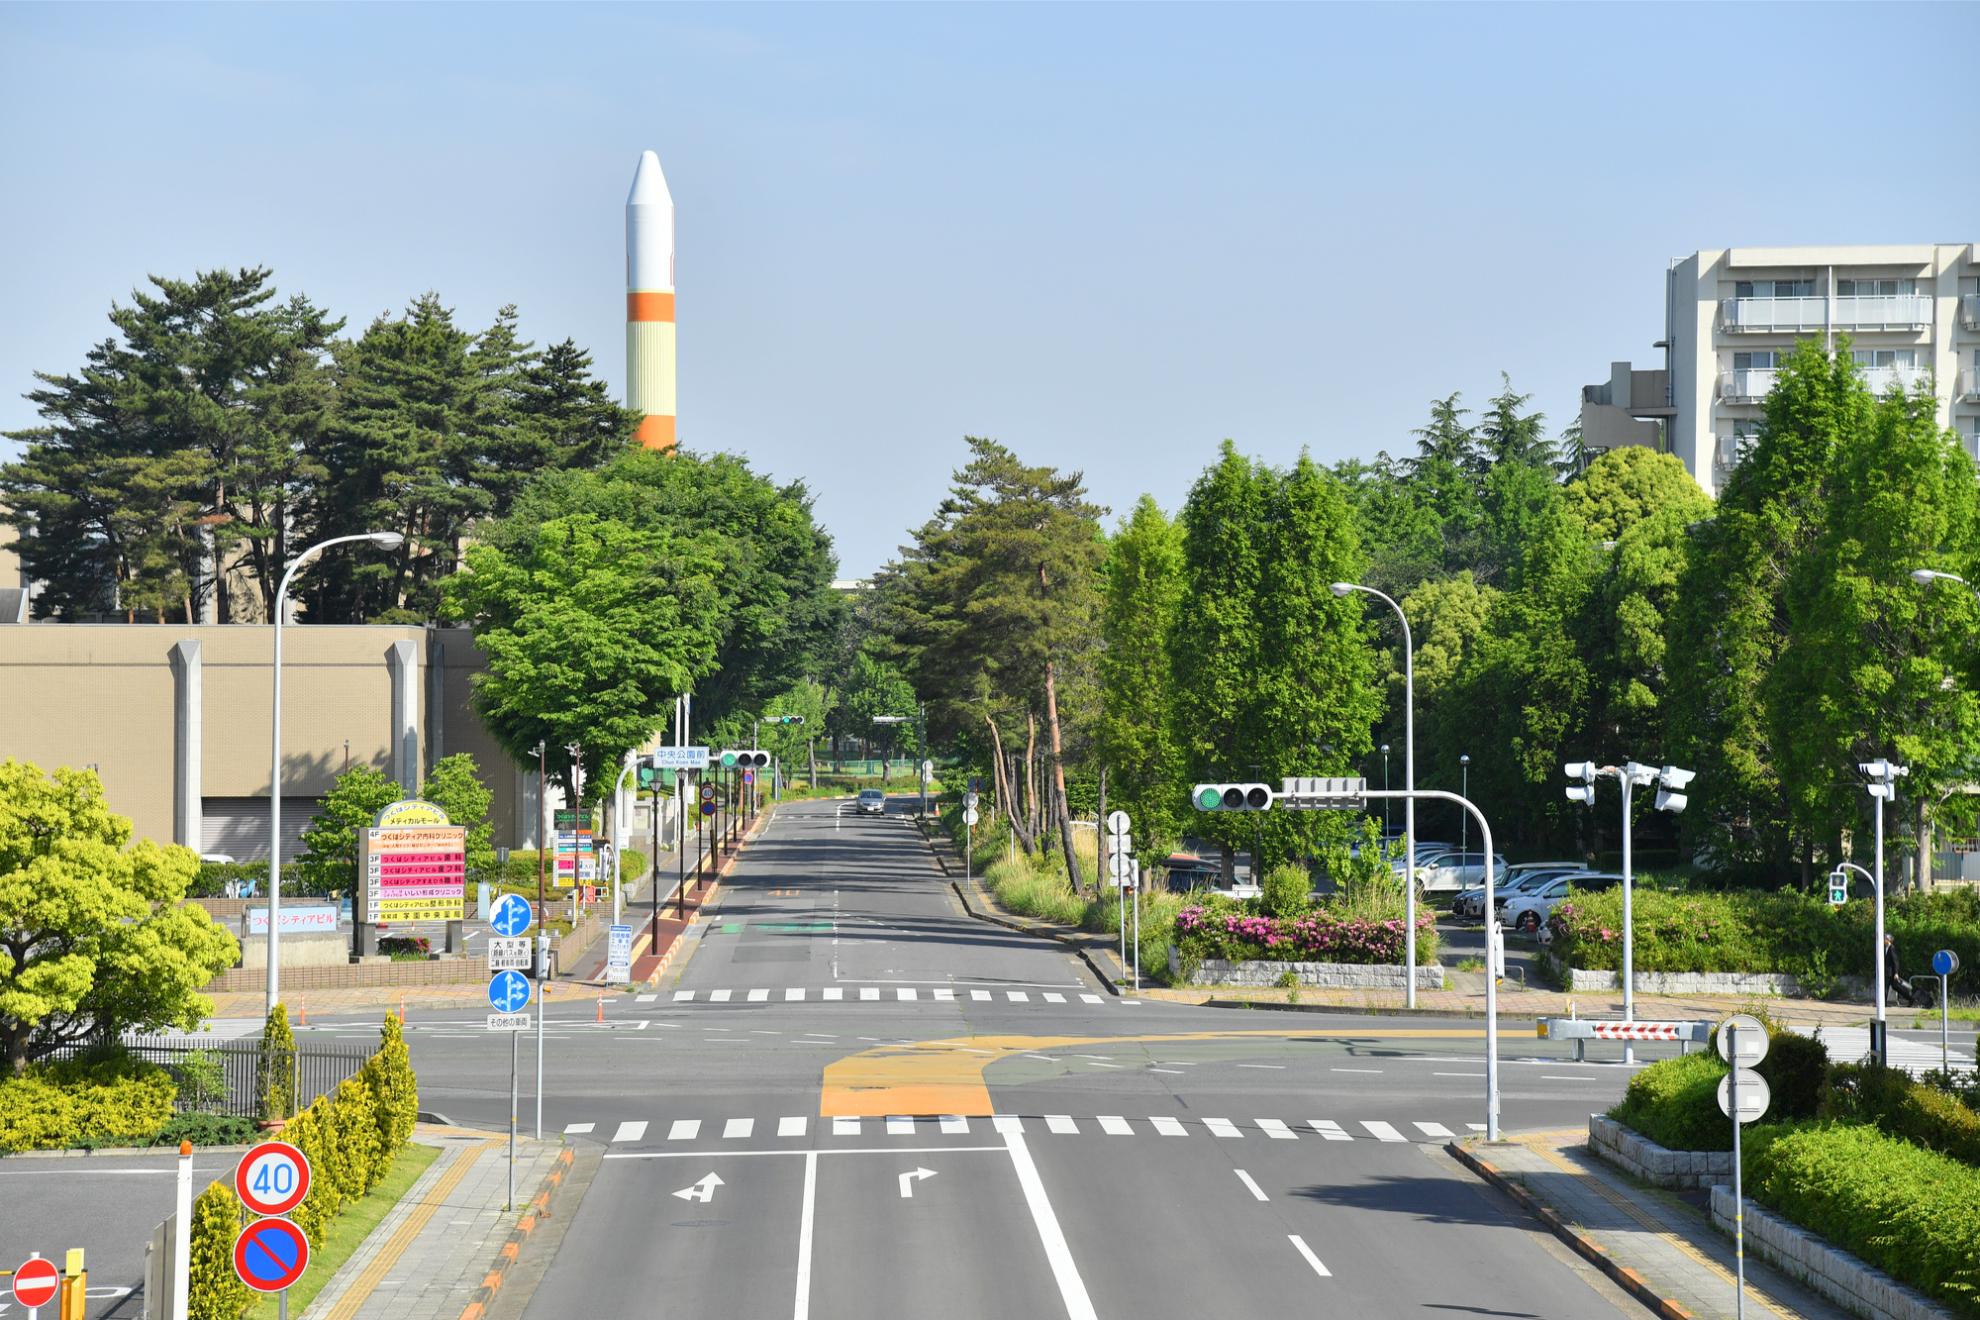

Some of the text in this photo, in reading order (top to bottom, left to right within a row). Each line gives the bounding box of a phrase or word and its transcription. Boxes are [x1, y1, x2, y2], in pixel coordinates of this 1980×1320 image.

[657, 750, 705, 759] 中央公園前
[703, 789, 713, 797] 40
[381, 832, 464, 840] つくばシティア内科クリニック
[370, 878, 379, 886] 3F
[255, 914, 334, 925] つくシティアビル
[490, 1018, 528, 1027] その他の車両
[253, 1163, 293, 1194] 40
